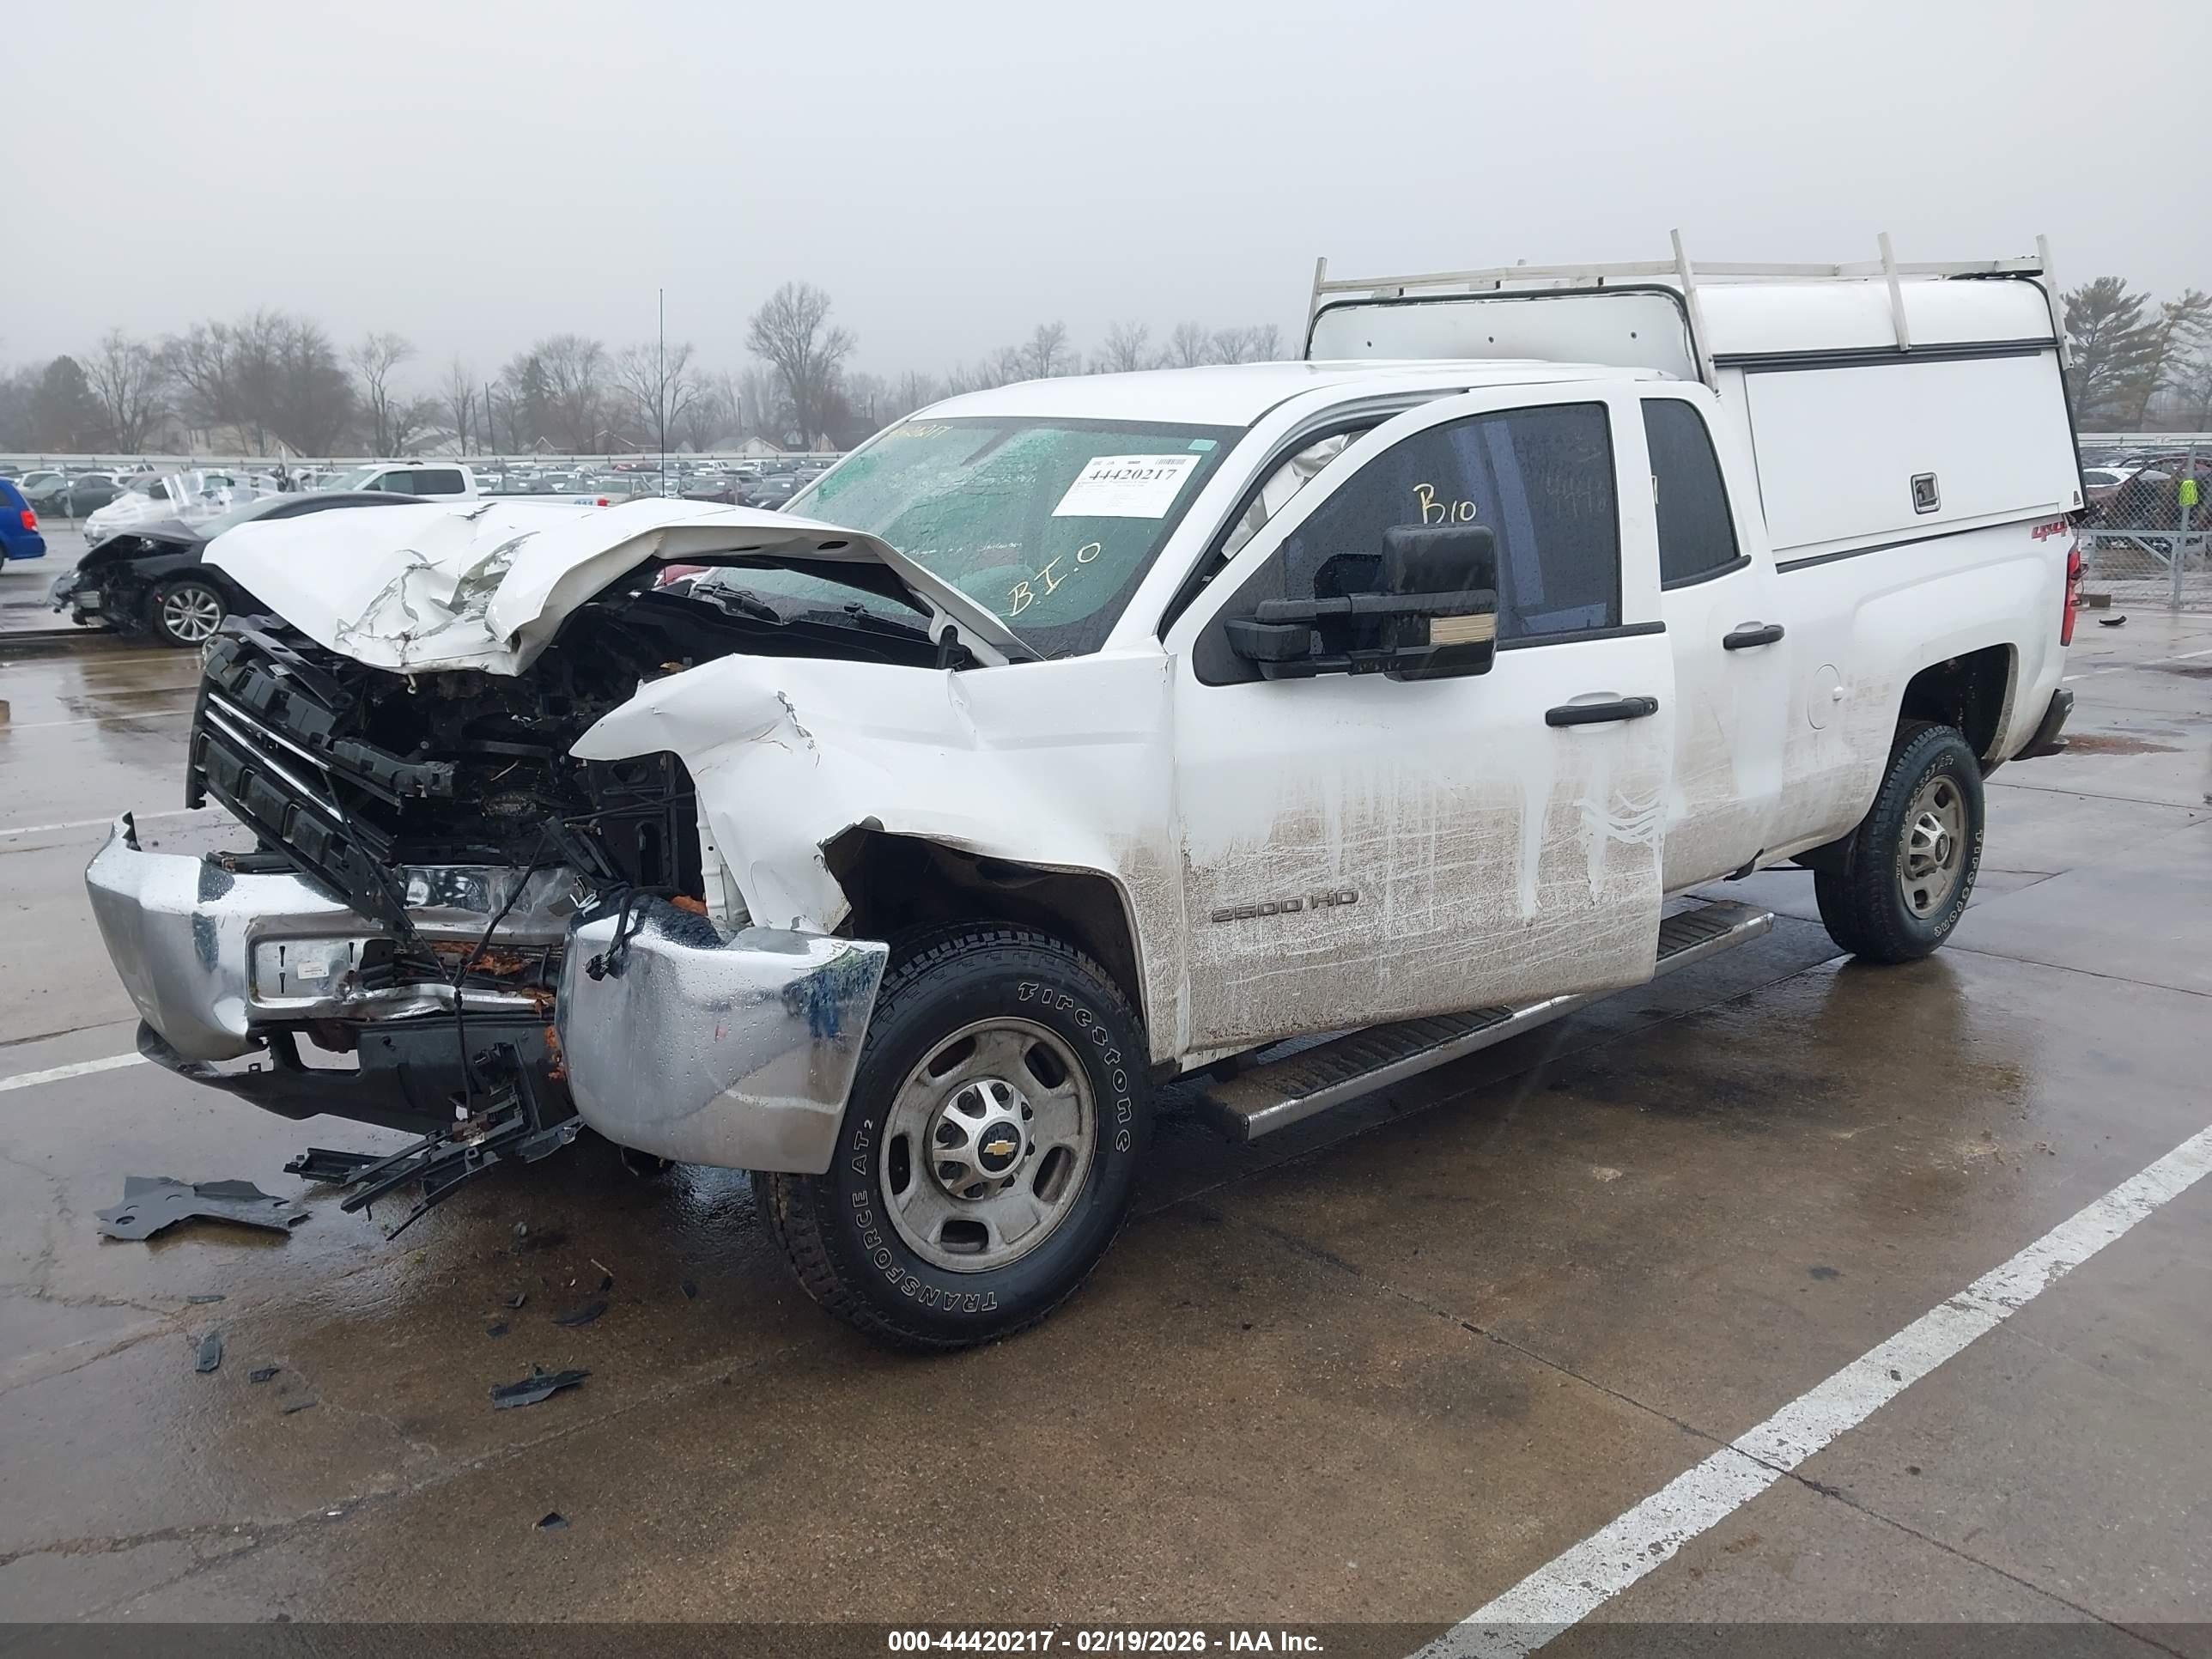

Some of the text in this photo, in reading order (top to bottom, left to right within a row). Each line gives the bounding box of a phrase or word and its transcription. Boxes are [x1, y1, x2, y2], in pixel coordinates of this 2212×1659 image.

[1089, 469, 1178, 481] 44420217
[1212, 888, 1359, 923] 2500 HD
[1018, 981, 1132, 1153] Firestone
[852, 1190, 999, 1313] TRANSFORCE
